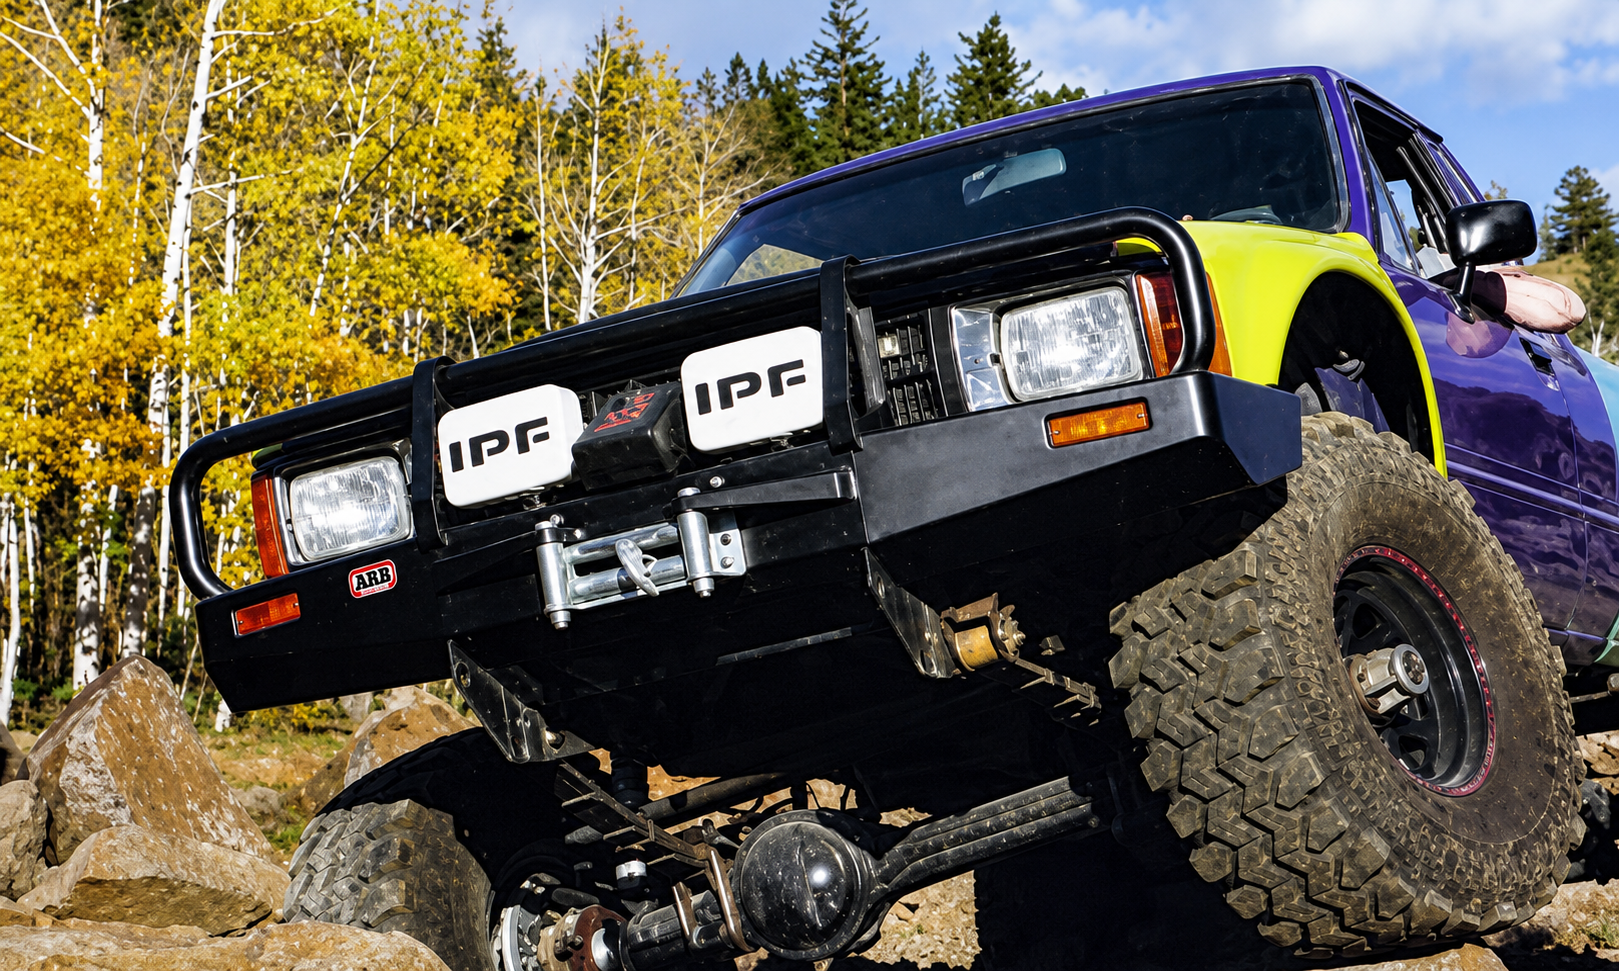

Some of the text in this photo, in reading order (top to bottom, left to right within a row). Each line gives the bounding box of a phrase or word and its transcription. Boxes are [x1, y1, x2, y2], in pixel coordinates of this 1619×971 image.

[695, 359, 806, 415] IPF
[449, 416, 550, 473] IPF
[355, 567, 392, 592] ARB
